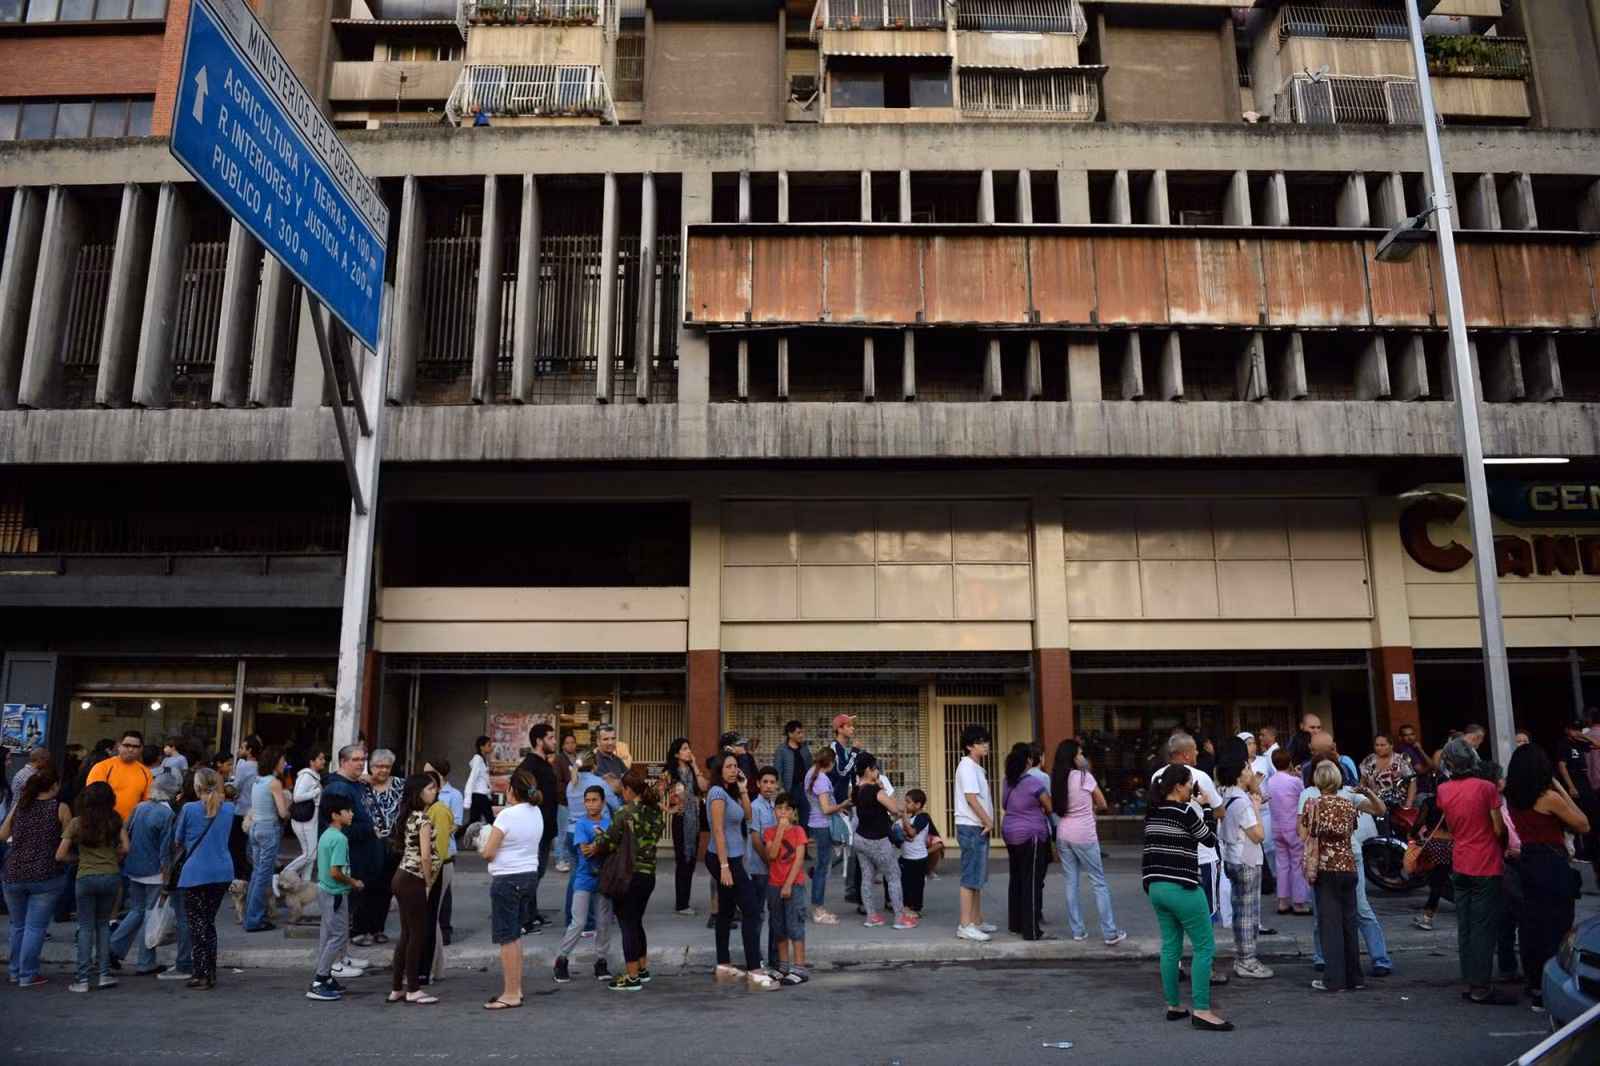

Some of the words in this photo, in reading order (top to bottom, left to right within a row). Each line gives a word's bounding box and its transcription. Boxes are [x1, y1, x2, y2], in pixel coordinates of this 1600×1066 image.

[212, 143, 261, 214] PUBLICO
[264, 202, 272, 229] A
[278, 217, 299, 254] 300
[300, 247, 308, 266] m
[218, 104, 228, 137] R.
[231, 119, 292, 207] INTERIORES
[295, 192, 303, 217] Y
[304, 208, 339, 262] JUSTICIA
[341, 251, 348, 273] A
[350, 260, 367, 292] 200
[223, 68, 298, 177] AGRICULTURA
[304, 162, 311, 188] Y
[313, 176, 347, 235] TIERRAS
[349, 225, 356, 247] A
[358, 233, 371, 263] 100
[248, 23, 310, 128] MINISTERIOS
[312, 114, 328, 156] DEL
[329, 139, 354, 190] PODER
[355, 177, 386, 234] POPULAR
